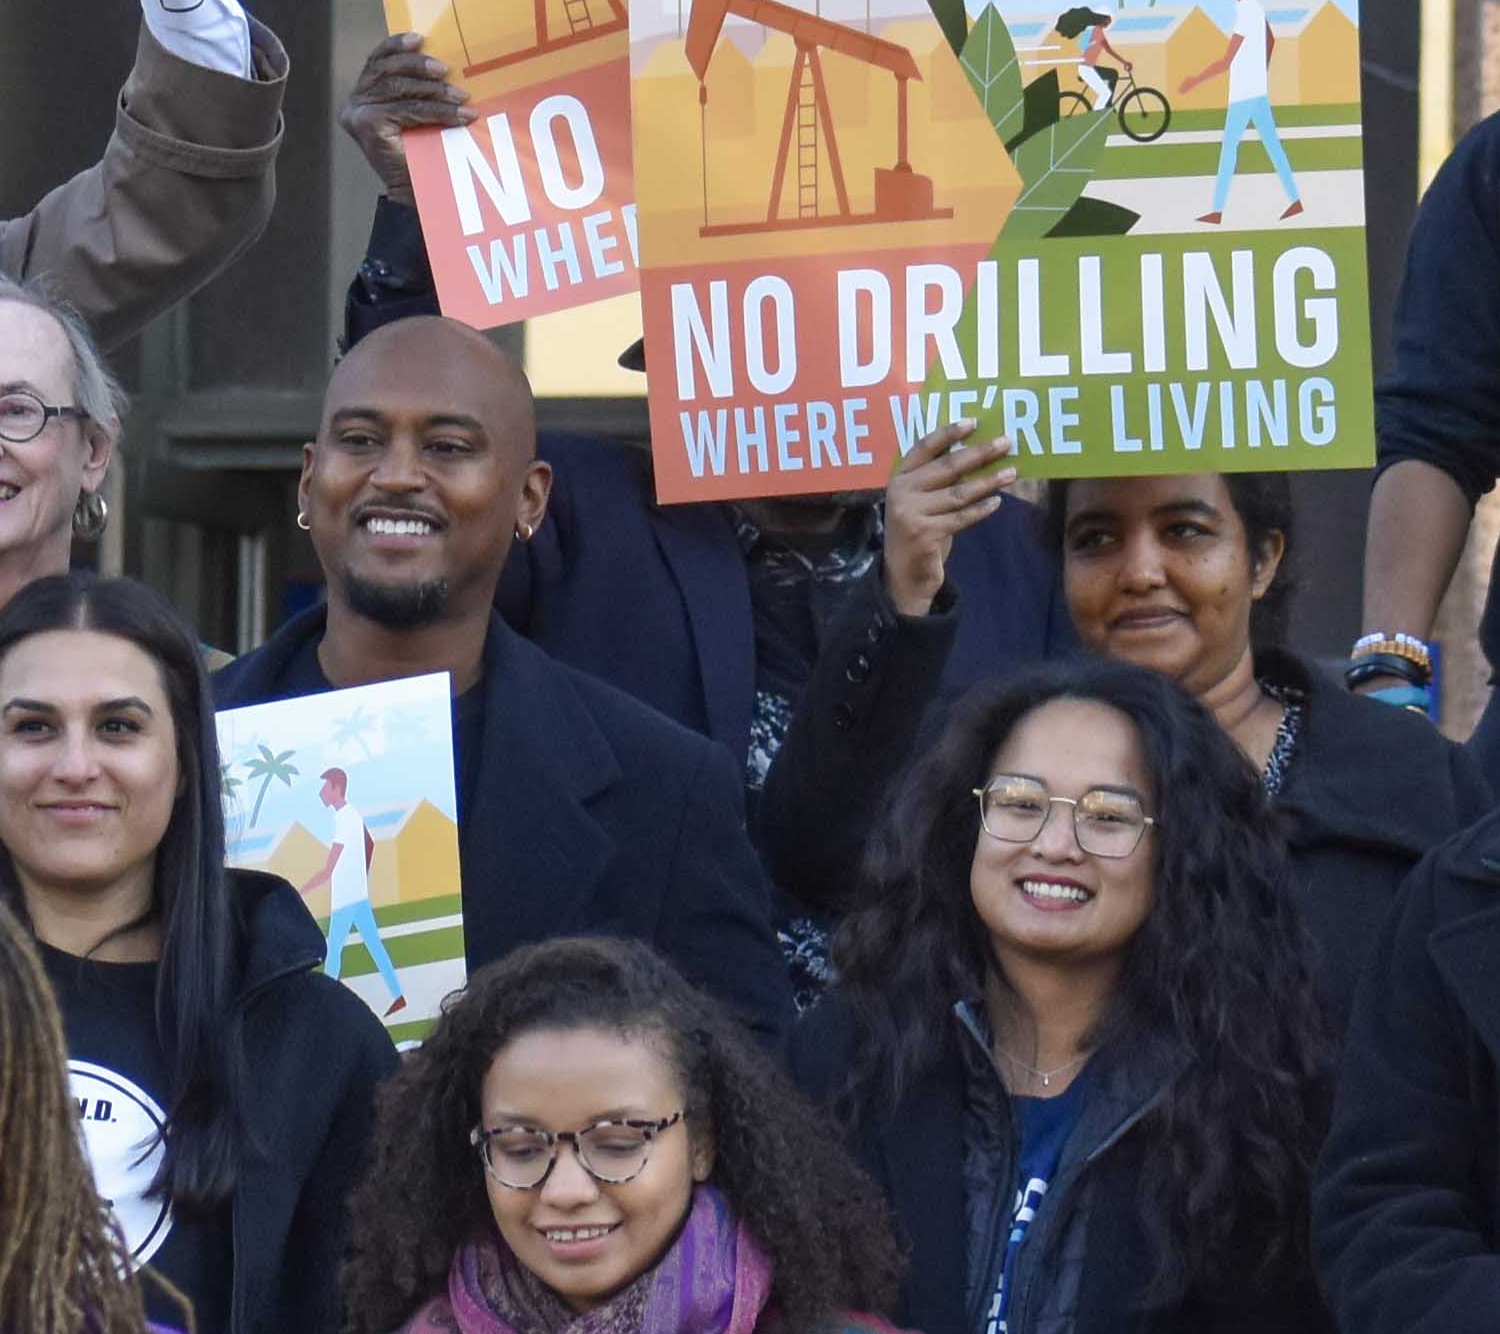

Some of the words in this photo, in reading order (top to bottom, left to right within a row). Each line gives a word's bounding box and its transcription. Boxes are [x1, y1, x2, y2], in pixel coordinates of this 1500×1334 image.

[440, 94, 605, 236] NO
[670, 275, 797, 401] NO
[839, 246, 1341, 389] DRILLING
[678, 397, 873, 479] WHERE
[1110, 377, 1338, 454] LIVING
